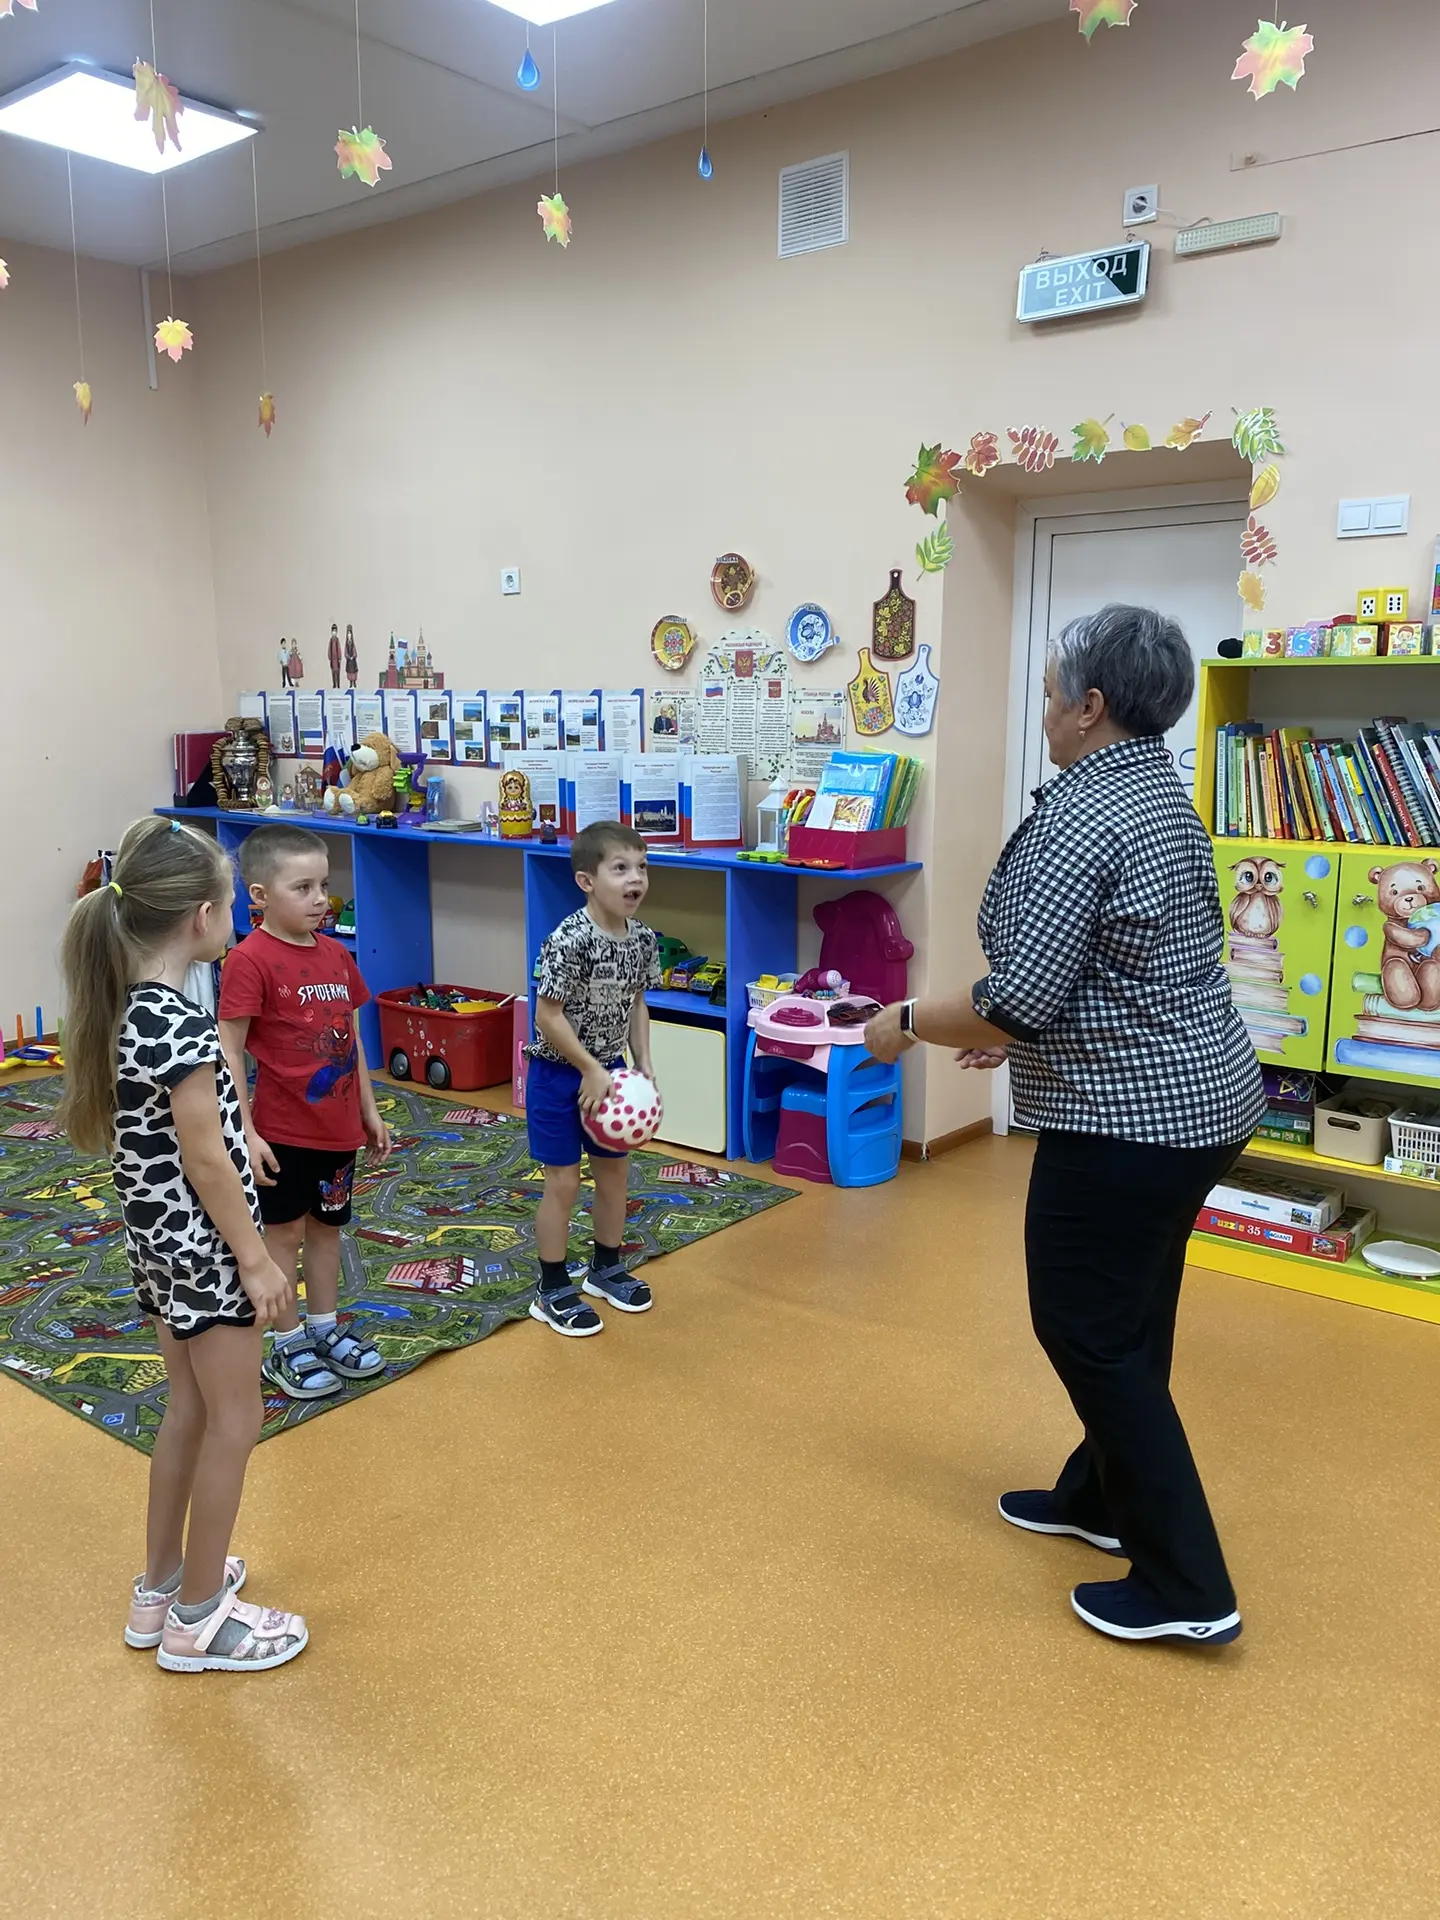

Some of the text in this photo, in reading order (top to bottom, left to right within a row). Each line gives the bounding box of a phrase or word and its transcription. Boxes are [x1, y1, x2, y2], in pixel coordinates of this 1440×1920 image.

[1035, 253, 1128, 290] ВЫХОД
[1055, 281, 1106, 307] EXIT
[1265, 631, 1282, 655] 3
[1292, 631, 1312, 654] 6
[1210, 1215, 1245, 1232] Puzzle
[1246, 1224, 1261, 1236] 35
